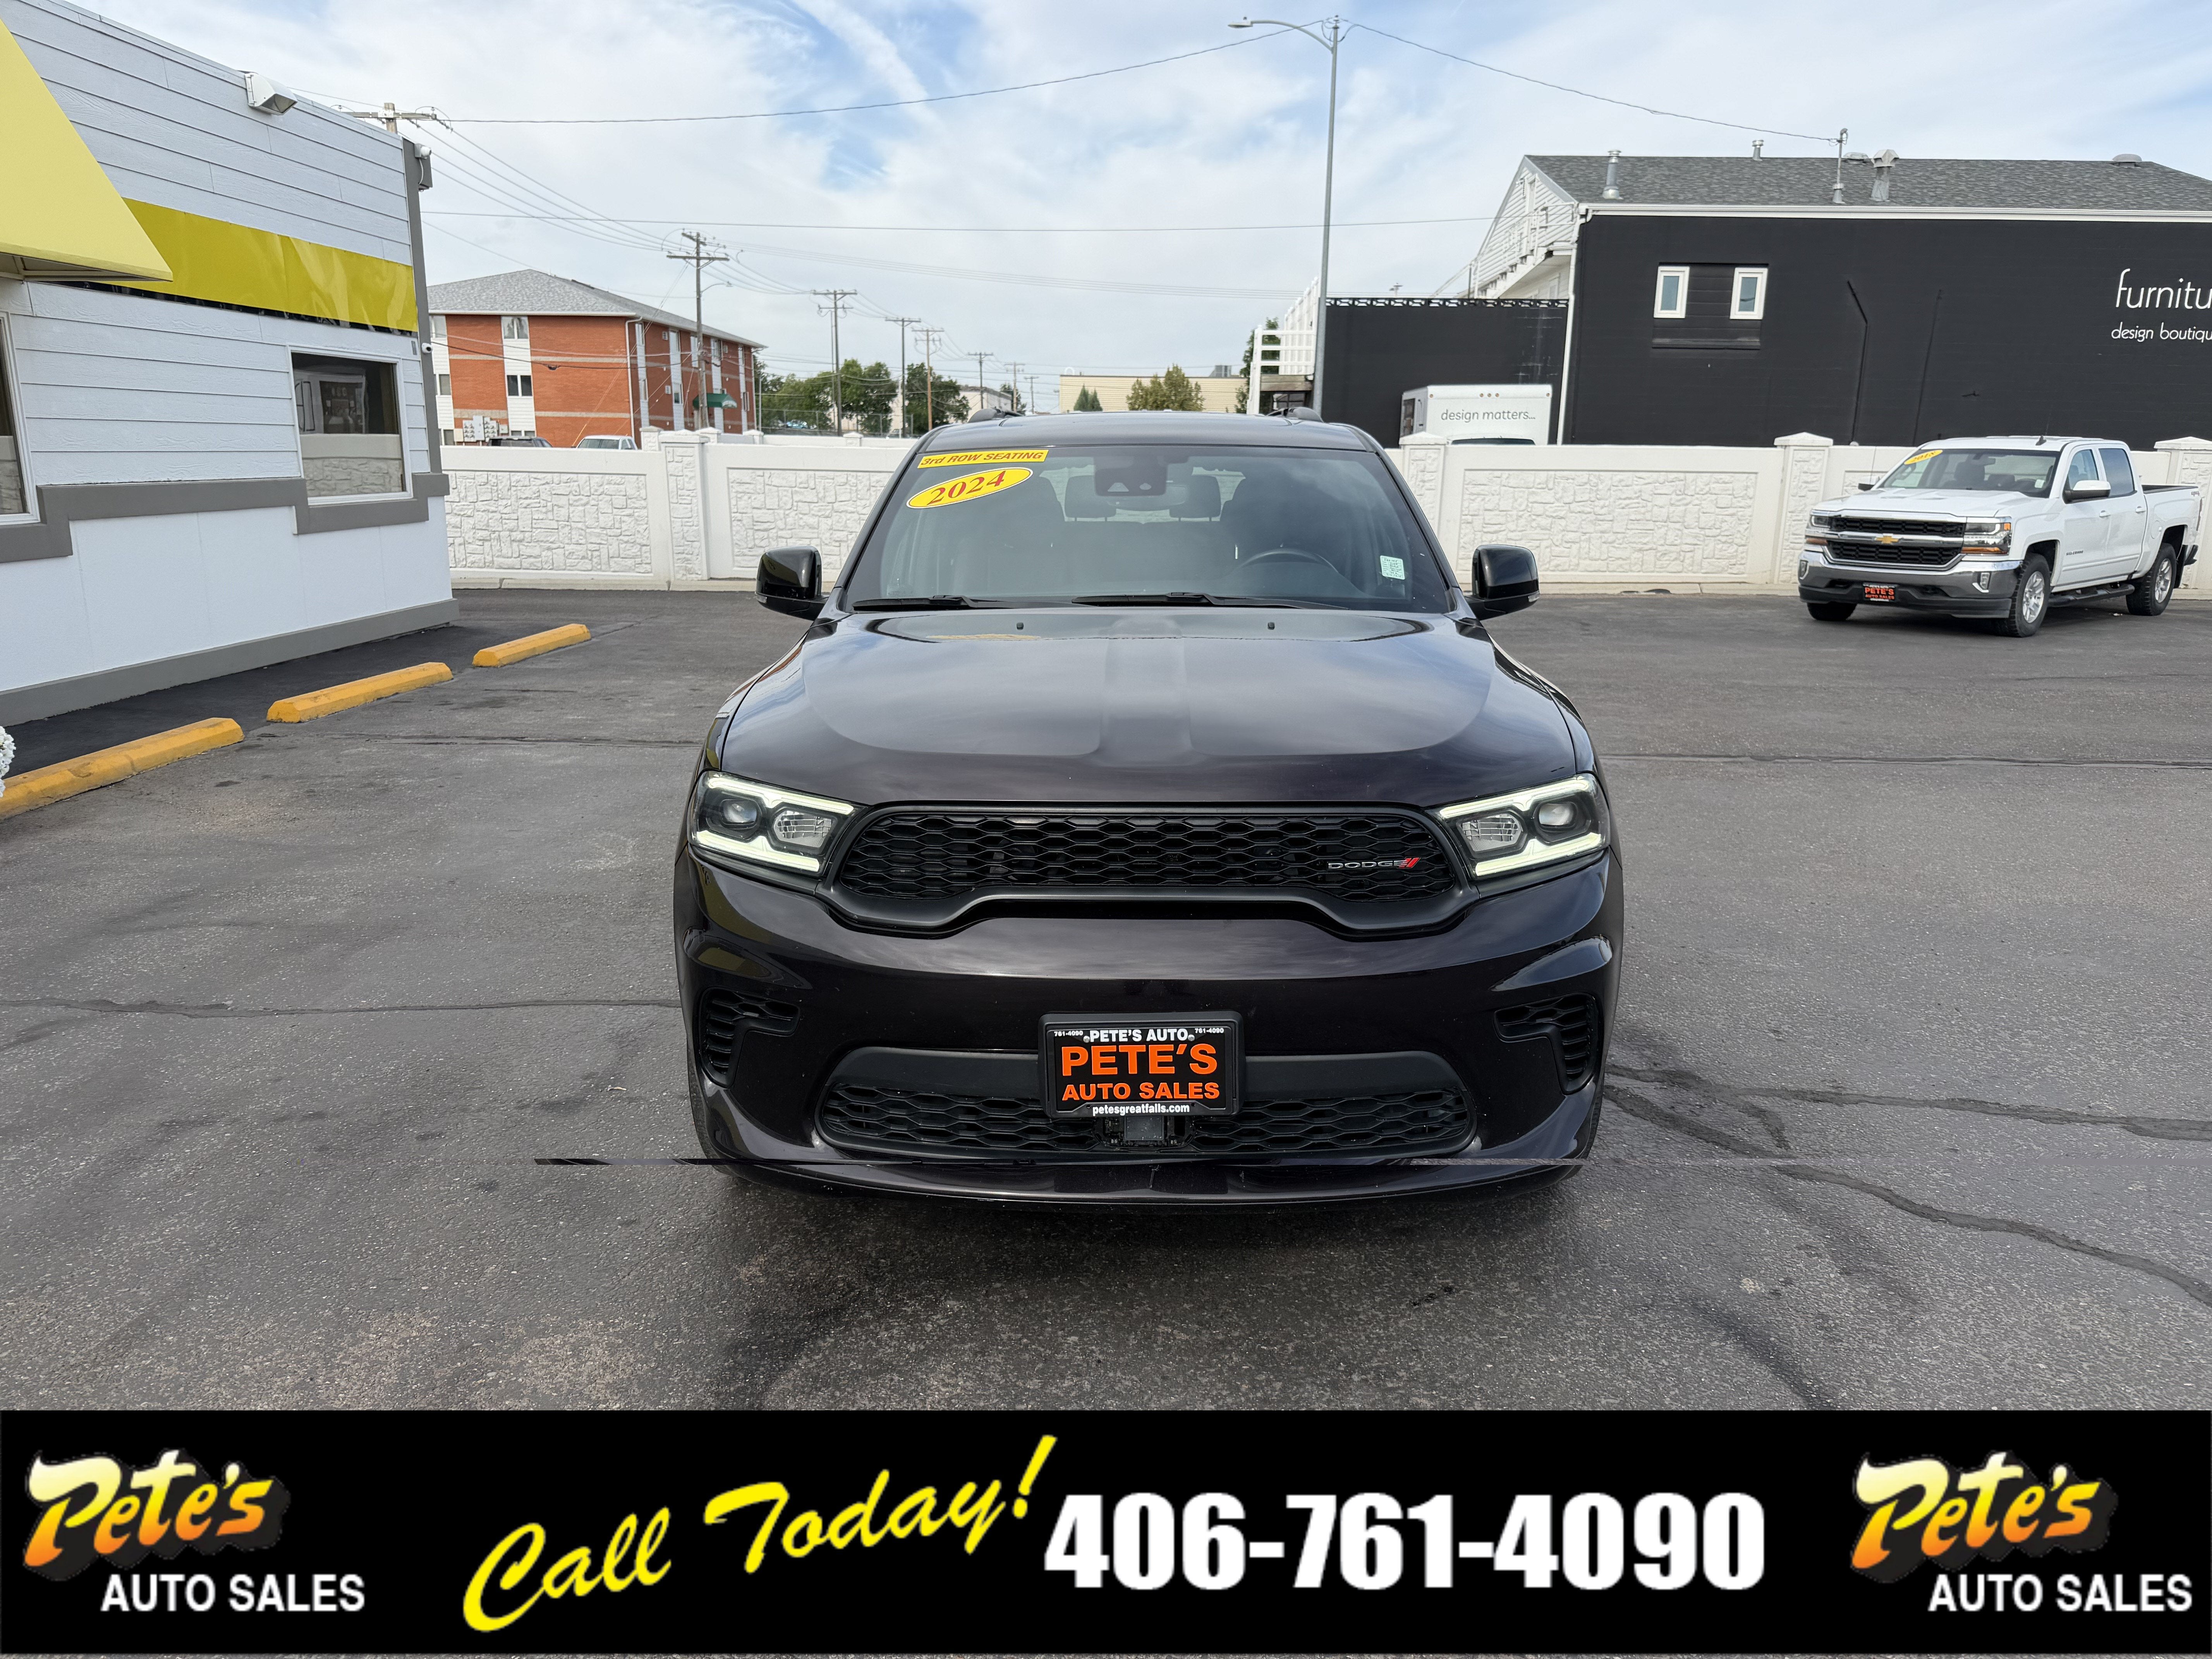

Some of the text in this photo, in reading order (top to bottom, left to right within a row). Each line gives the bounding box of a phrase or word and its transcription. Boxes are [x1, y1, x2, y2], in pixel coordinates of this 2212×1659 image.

[2116, 268, 2212, 309] furnitu
[2111, 321, 2154, 342] design
[1441, 409, 1535, 423] design matters...
[921, 452, 1044, 465] 3rd ROW SEATING
[927, 471, 1007, 505] 2024
[1328, 860, 1408, 869] DODGE
[1089, 1029, 1188, 1042] PETE'S AUTO
[1061, 1044, 1218, 1076] PETE'S
[1062, 1082, 1220, 1101] AUTO SALES
[1092, 1104, 1190, 1116] petesgreatfalls.com
